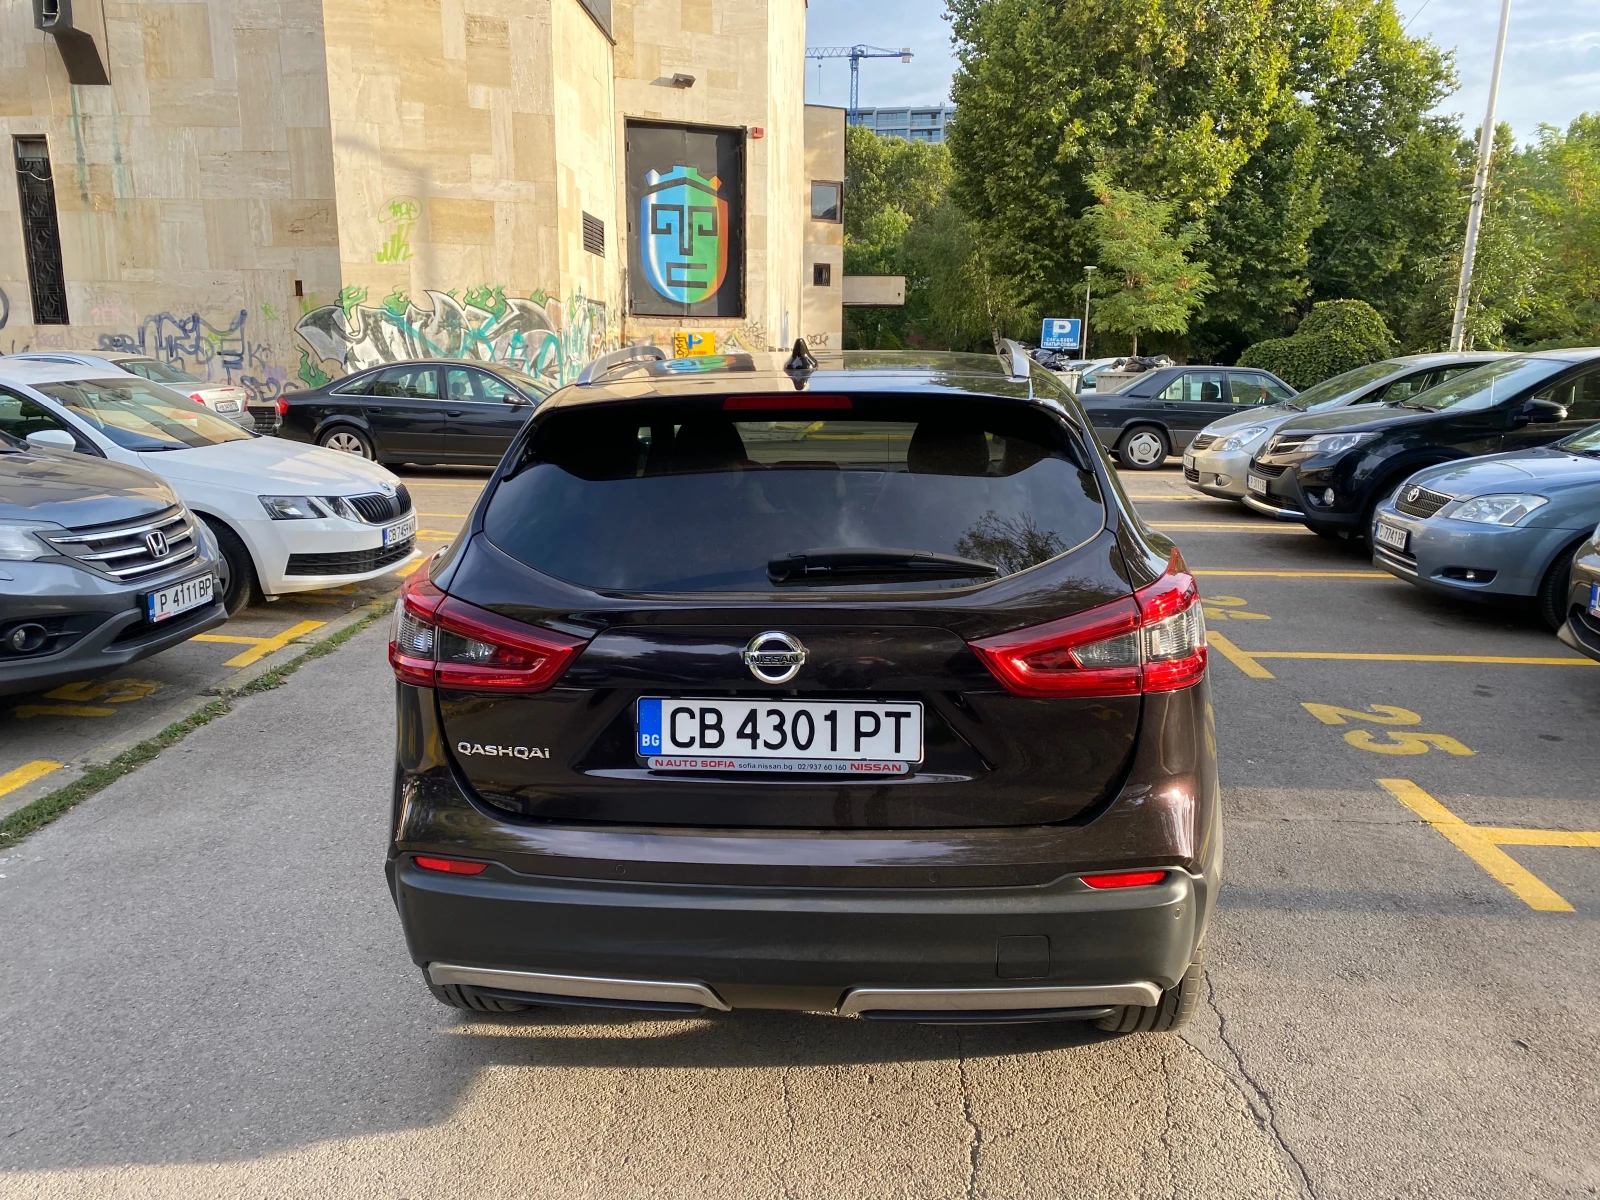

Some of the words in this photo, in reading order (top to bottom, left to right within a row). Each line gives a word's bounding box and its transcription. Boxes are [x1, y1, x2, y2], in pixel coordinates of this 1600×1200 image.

[1053, 320, 1071, 337] P
[160, 593, 168, 612] P
[750, 654, 799, 664] NISSAN
[670, 706, 725, 749] CB
[736, 708, 838, 753] 4301
[854, 710, 912, 754] PT
[1300, 702, 1476, 756] 25
[642, 733, 660, 747] BG
[665, 759, 698, 768] AUTO
[700, 760, 736, 769] SOFIA
[738, 762, 793, 771] sofia.nissan.bg
[834, 764, 847, 772] 160
[850, 763, 902, 772] NISSAN
